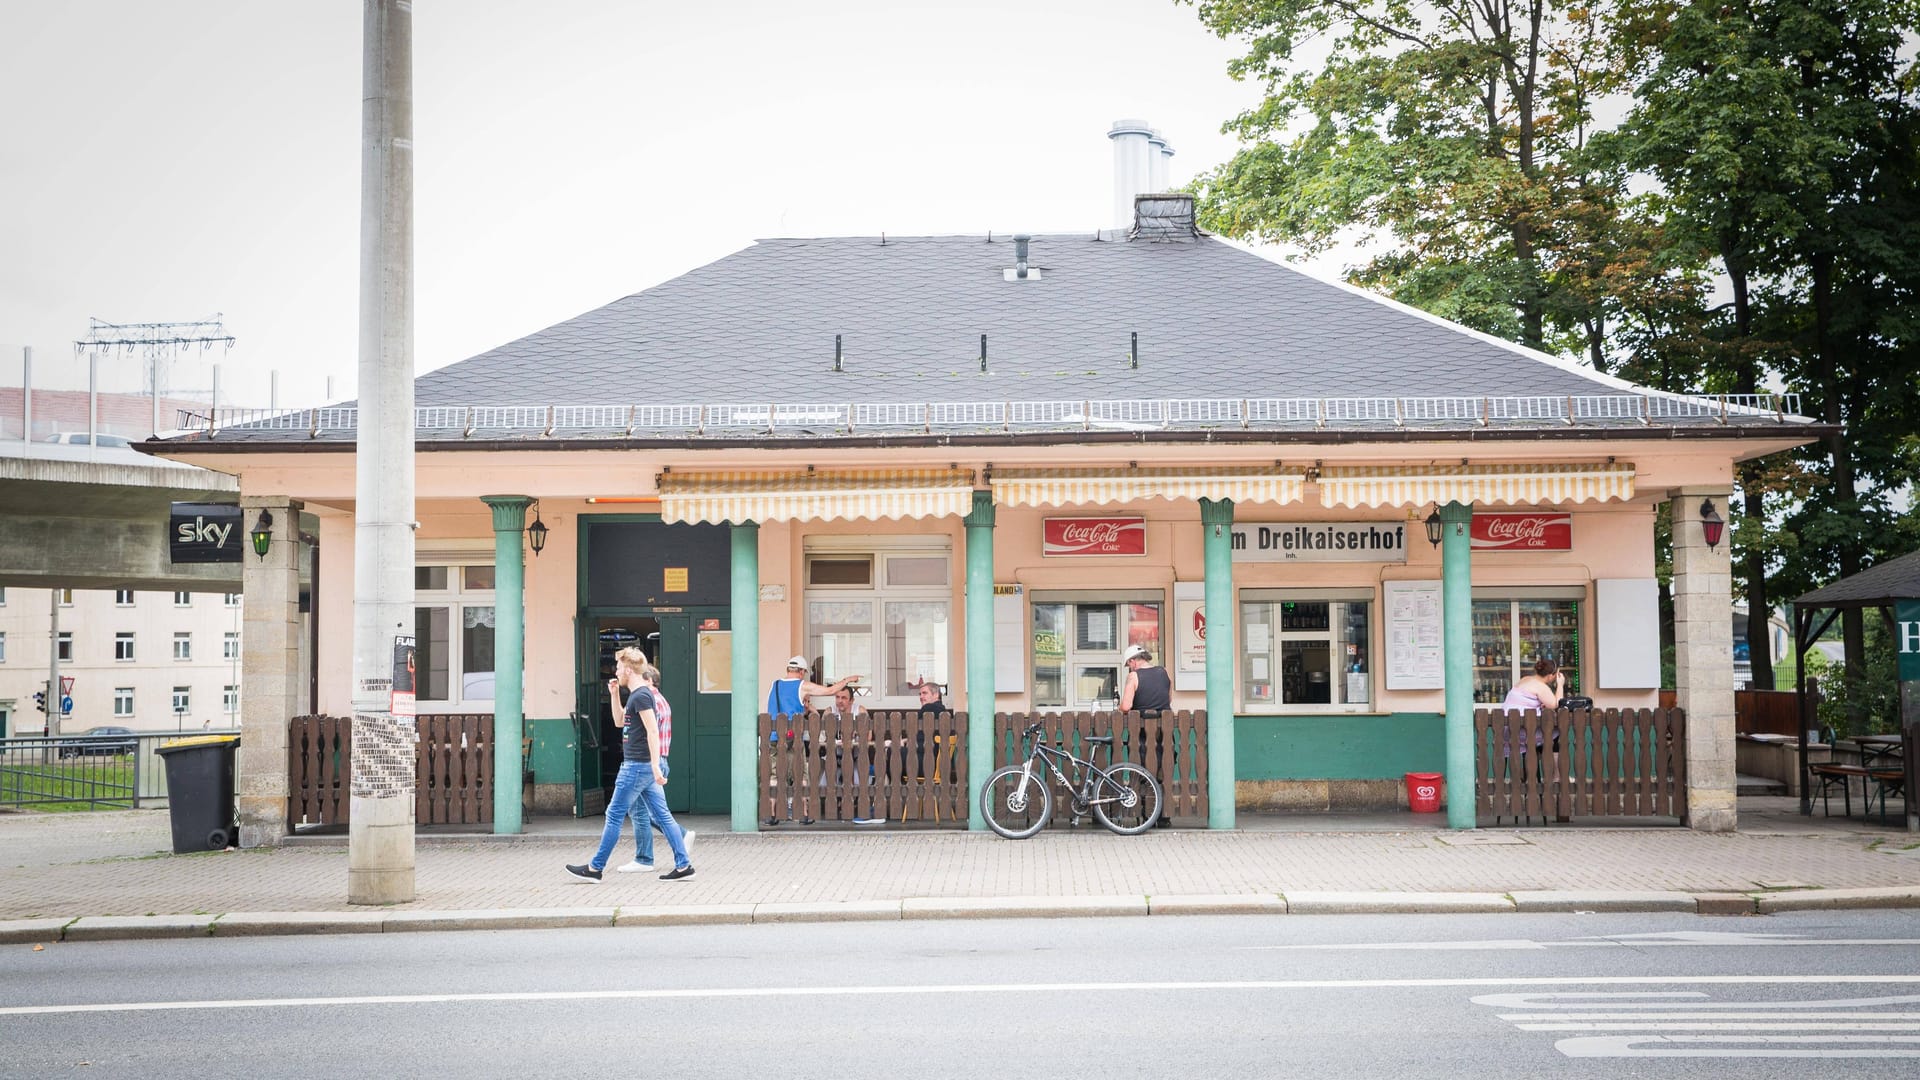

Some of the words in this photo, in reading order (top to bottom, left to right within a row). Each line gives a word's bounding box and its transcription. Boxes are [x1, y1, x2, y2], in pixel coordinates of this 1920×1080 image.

[178, 516, 233, 549] sky
[1063, 523, 1120, 543] Coca-Cola
[1258, 526, 1403, 550] Dreikaiserhof
[1487, 518, 1545, 538] Coca-Cola
